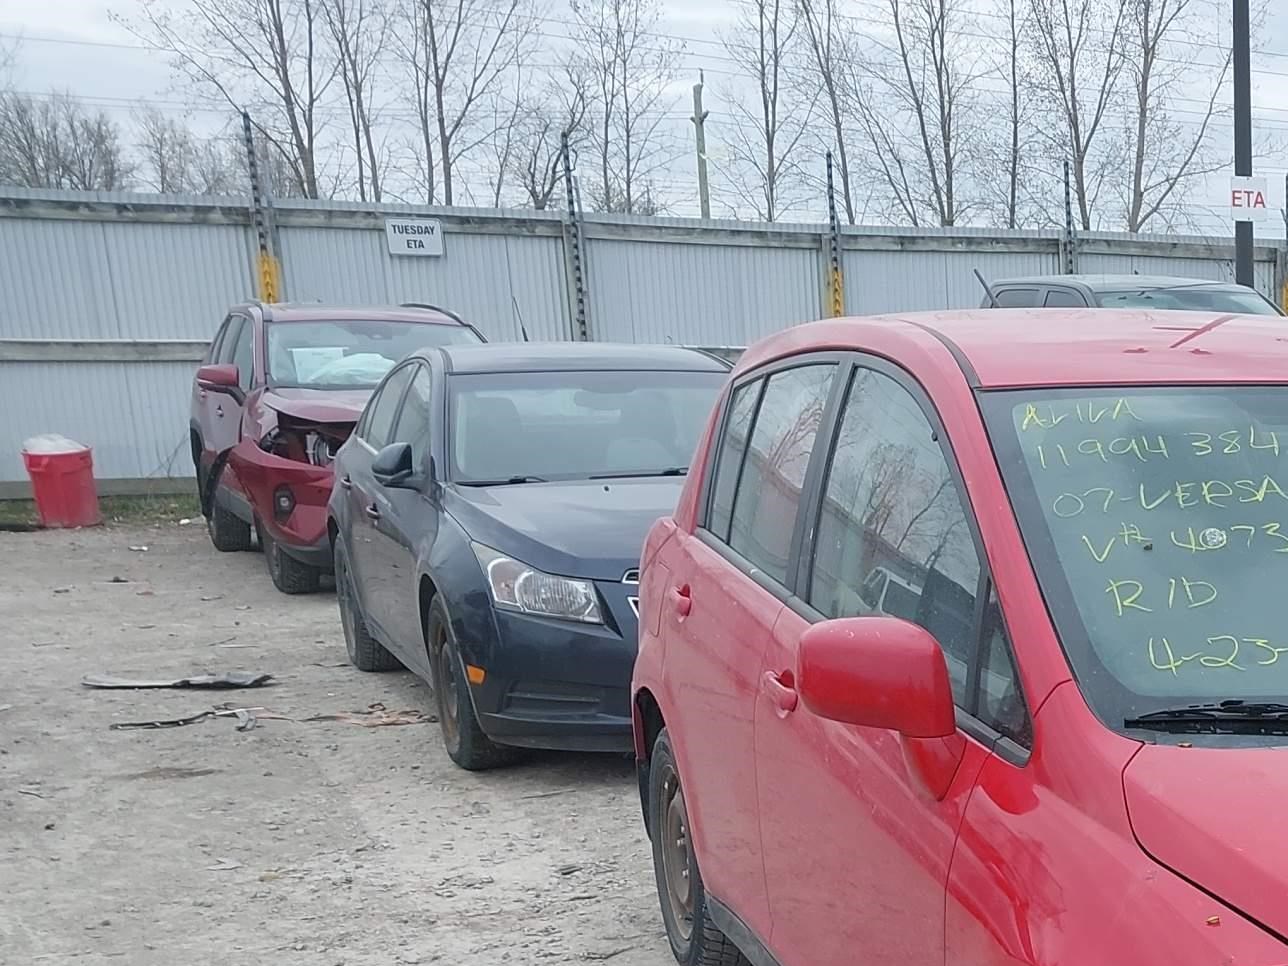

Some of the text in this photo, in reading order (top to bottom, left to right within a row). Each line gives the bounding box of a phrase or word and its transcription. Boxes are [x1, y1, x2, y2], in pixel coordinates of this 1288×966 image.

[1231, 190, 1266, 208] ETA
[391, 224, 435, 235] TUESDAY
[406, 239, 425, 249] ETA
